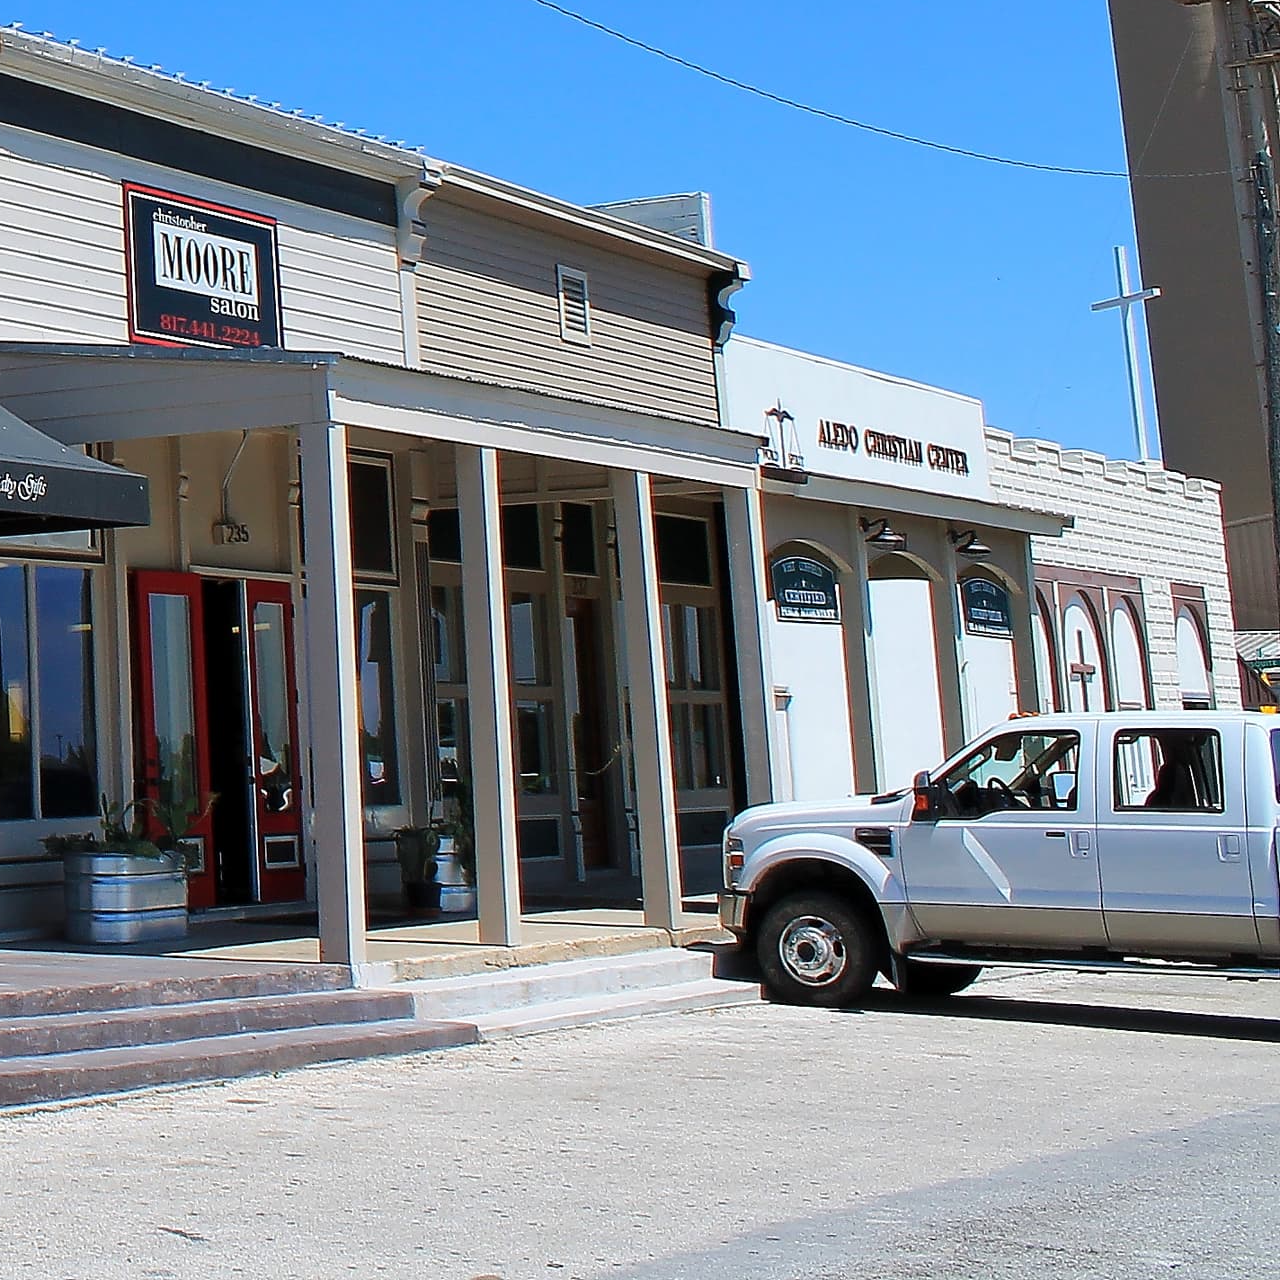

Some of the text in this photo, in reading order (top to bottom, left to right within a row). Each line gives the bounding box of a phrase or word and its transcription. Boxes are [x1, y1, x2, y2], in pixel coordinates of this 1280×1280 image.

[152, 207, 208, 232] christopher
[159, 231, 253, 296] MOORE
[210, 297, 260, 322] salon
[159, 314, 261, 347] 817.441.2224
[818, 419, 970, 474] ALEDO CHRISTIAN CENTER
[17, 473, 48, 502] Gifts
[226, 524, 250, 543] 235
